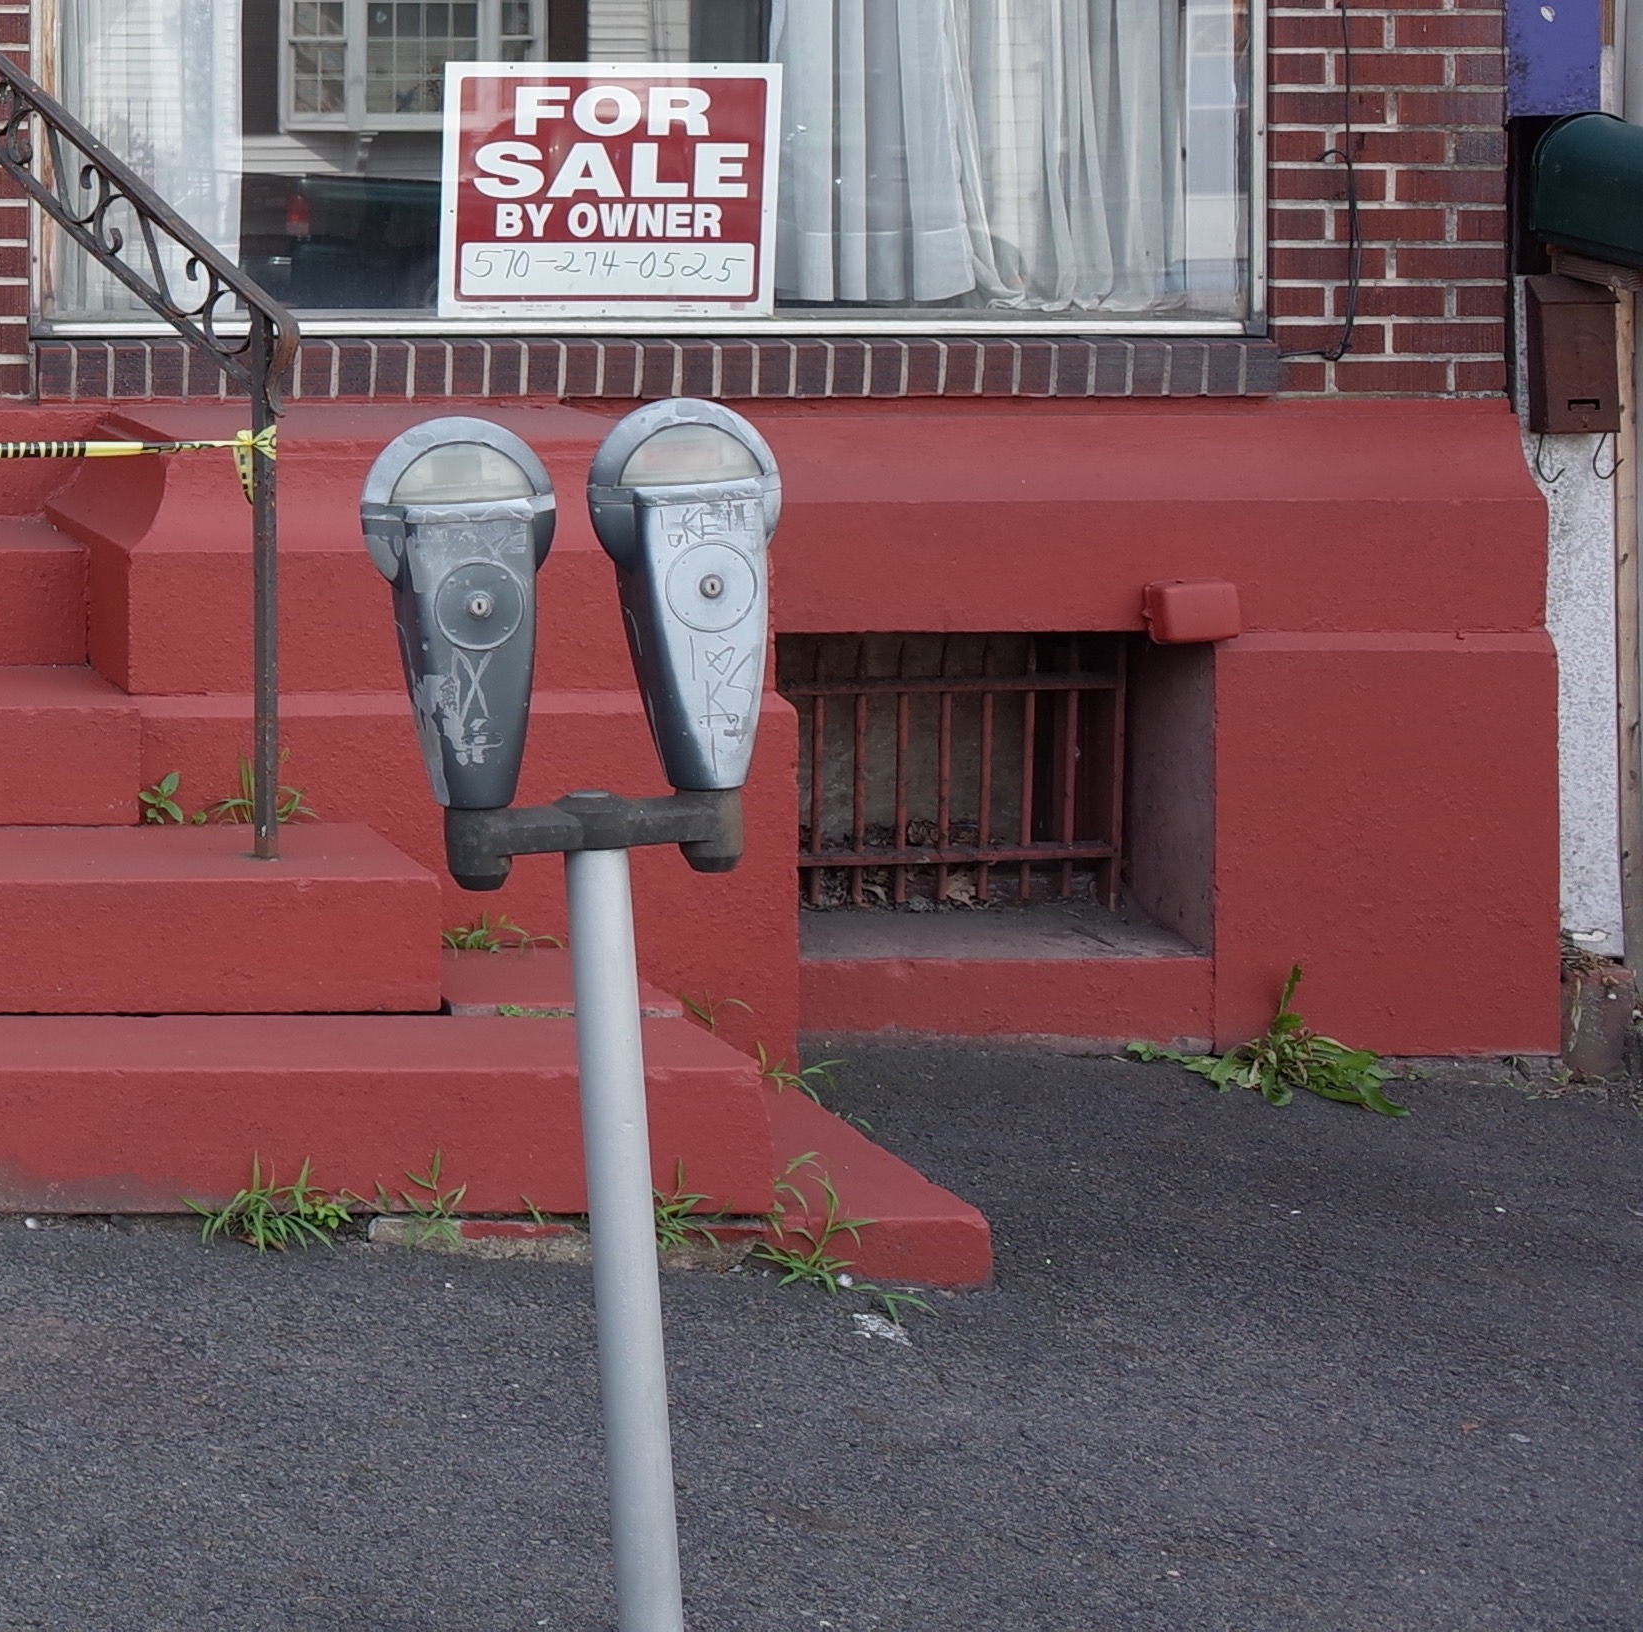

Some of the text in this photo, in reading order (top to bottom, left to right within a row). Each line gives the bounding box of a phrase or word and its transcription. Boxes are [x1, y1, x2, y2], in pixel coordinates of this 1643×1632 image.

[513, 85, 711, 138] FOR
[473, 141, 749, 199] SALE
[495, 203, 723, 239] BY OWNER
[465, 248, 746, 285] 570-274-0525
